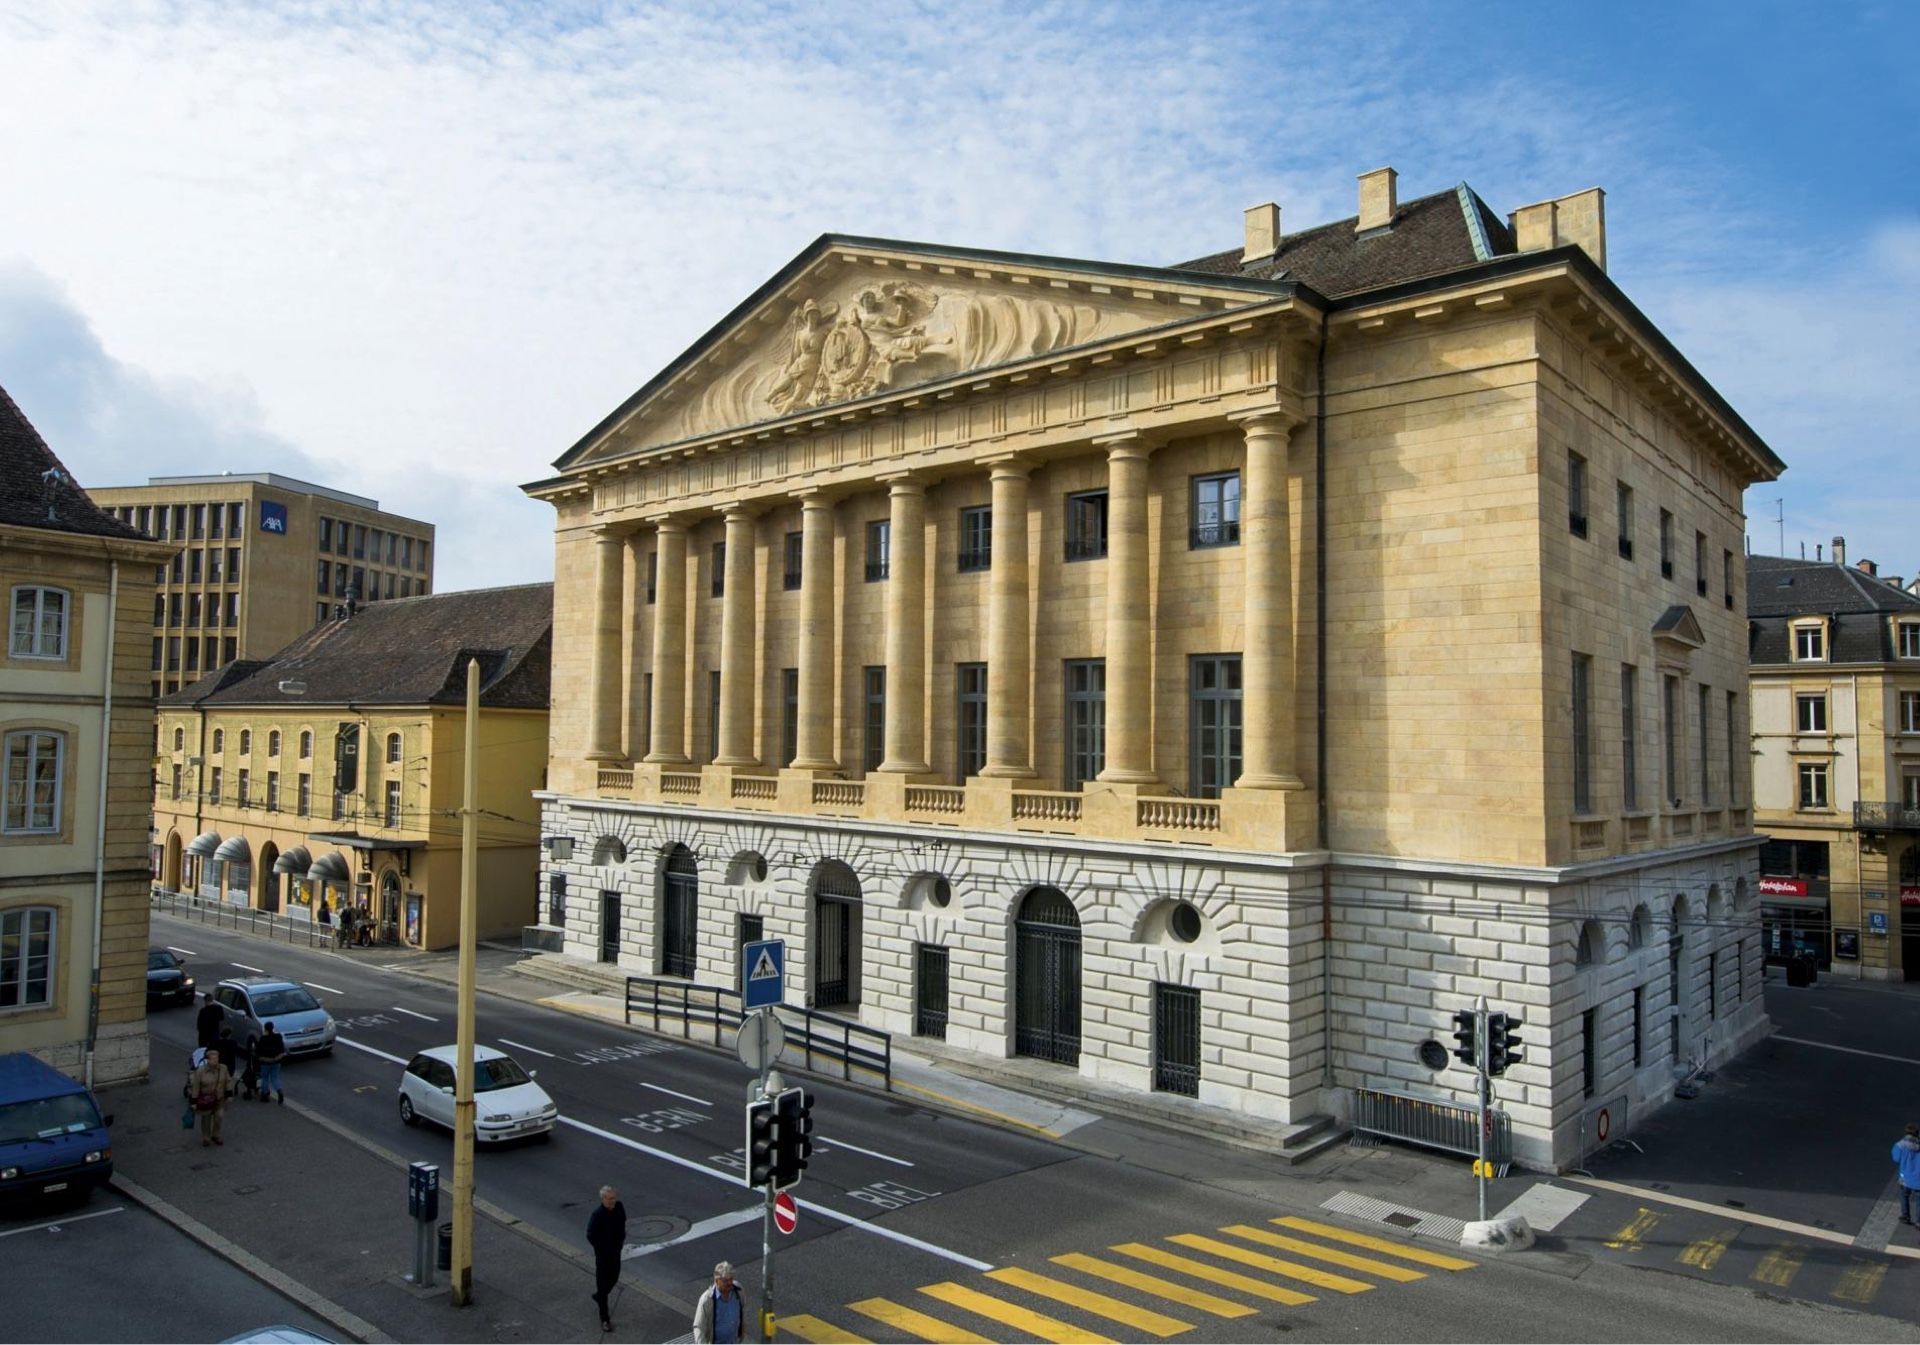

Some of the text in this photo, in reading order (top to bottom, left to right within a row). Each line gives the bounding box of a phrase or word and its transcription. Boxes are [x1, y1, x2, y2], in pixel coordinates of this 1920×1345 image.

[263, 517, 282, 531] AXA
[556, 1040, 685, 1066] LAUSANNE
[619, 1107, 713, 1133] BERN
[845, 1180, 942, 1209] BIEL
